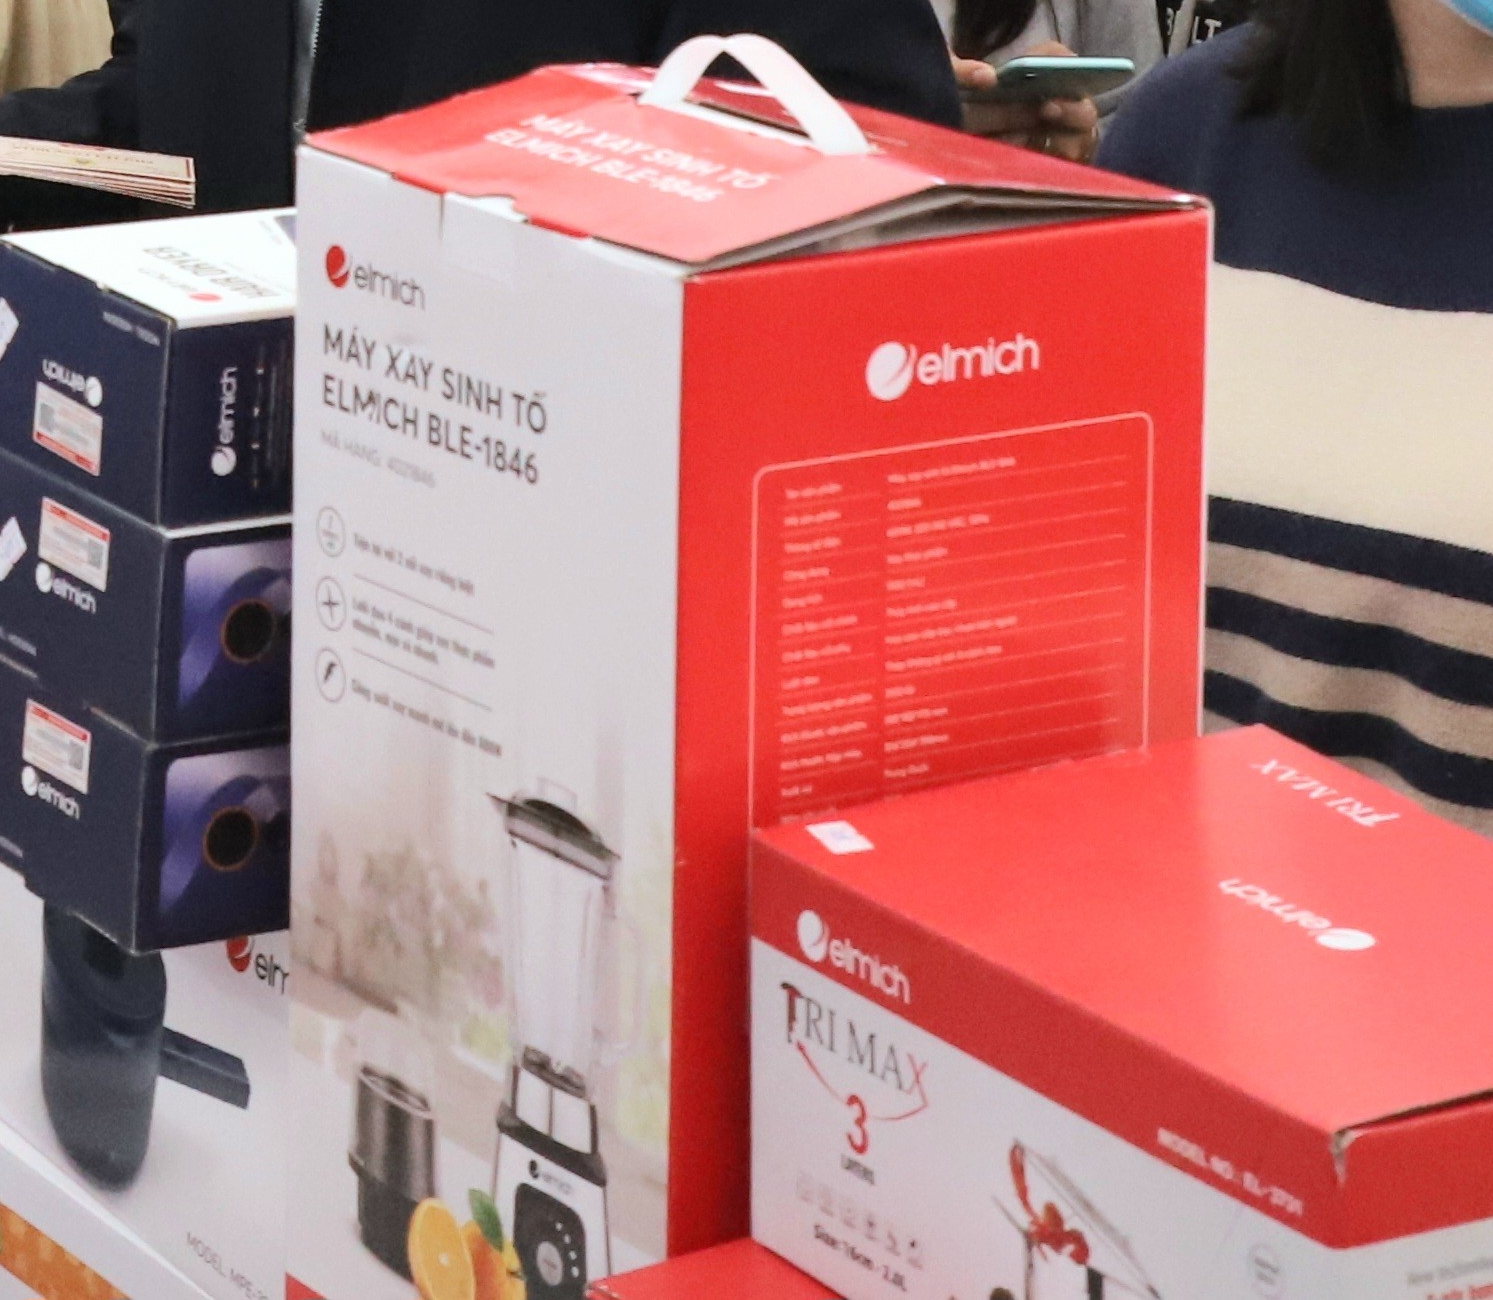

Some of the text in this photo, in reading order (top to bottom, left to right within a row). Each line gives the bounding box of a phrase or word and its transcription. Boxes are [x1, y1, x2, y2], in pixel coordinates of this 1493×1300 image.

[353, 262, 426, 311] elmich
[42, 358, 87, 394] elmich
[323, 322, 548, 435] MÁY XAY SINH TỐ
[916, 331, 1041, 388] elmich
[216, 365, 239, 445] elmich
[322, 372, 539, 486] ELMICH BLE-1846
[50, 575, 98, 615] elmich
[36, 781, 81, 822] elmich
[1218, 878, 1333, 931] elmich
[828, 937, 912, 1005] elmich
[780, 981, 929, 1095] TRI MAX
[845, 1093, 869, 1155] 3
